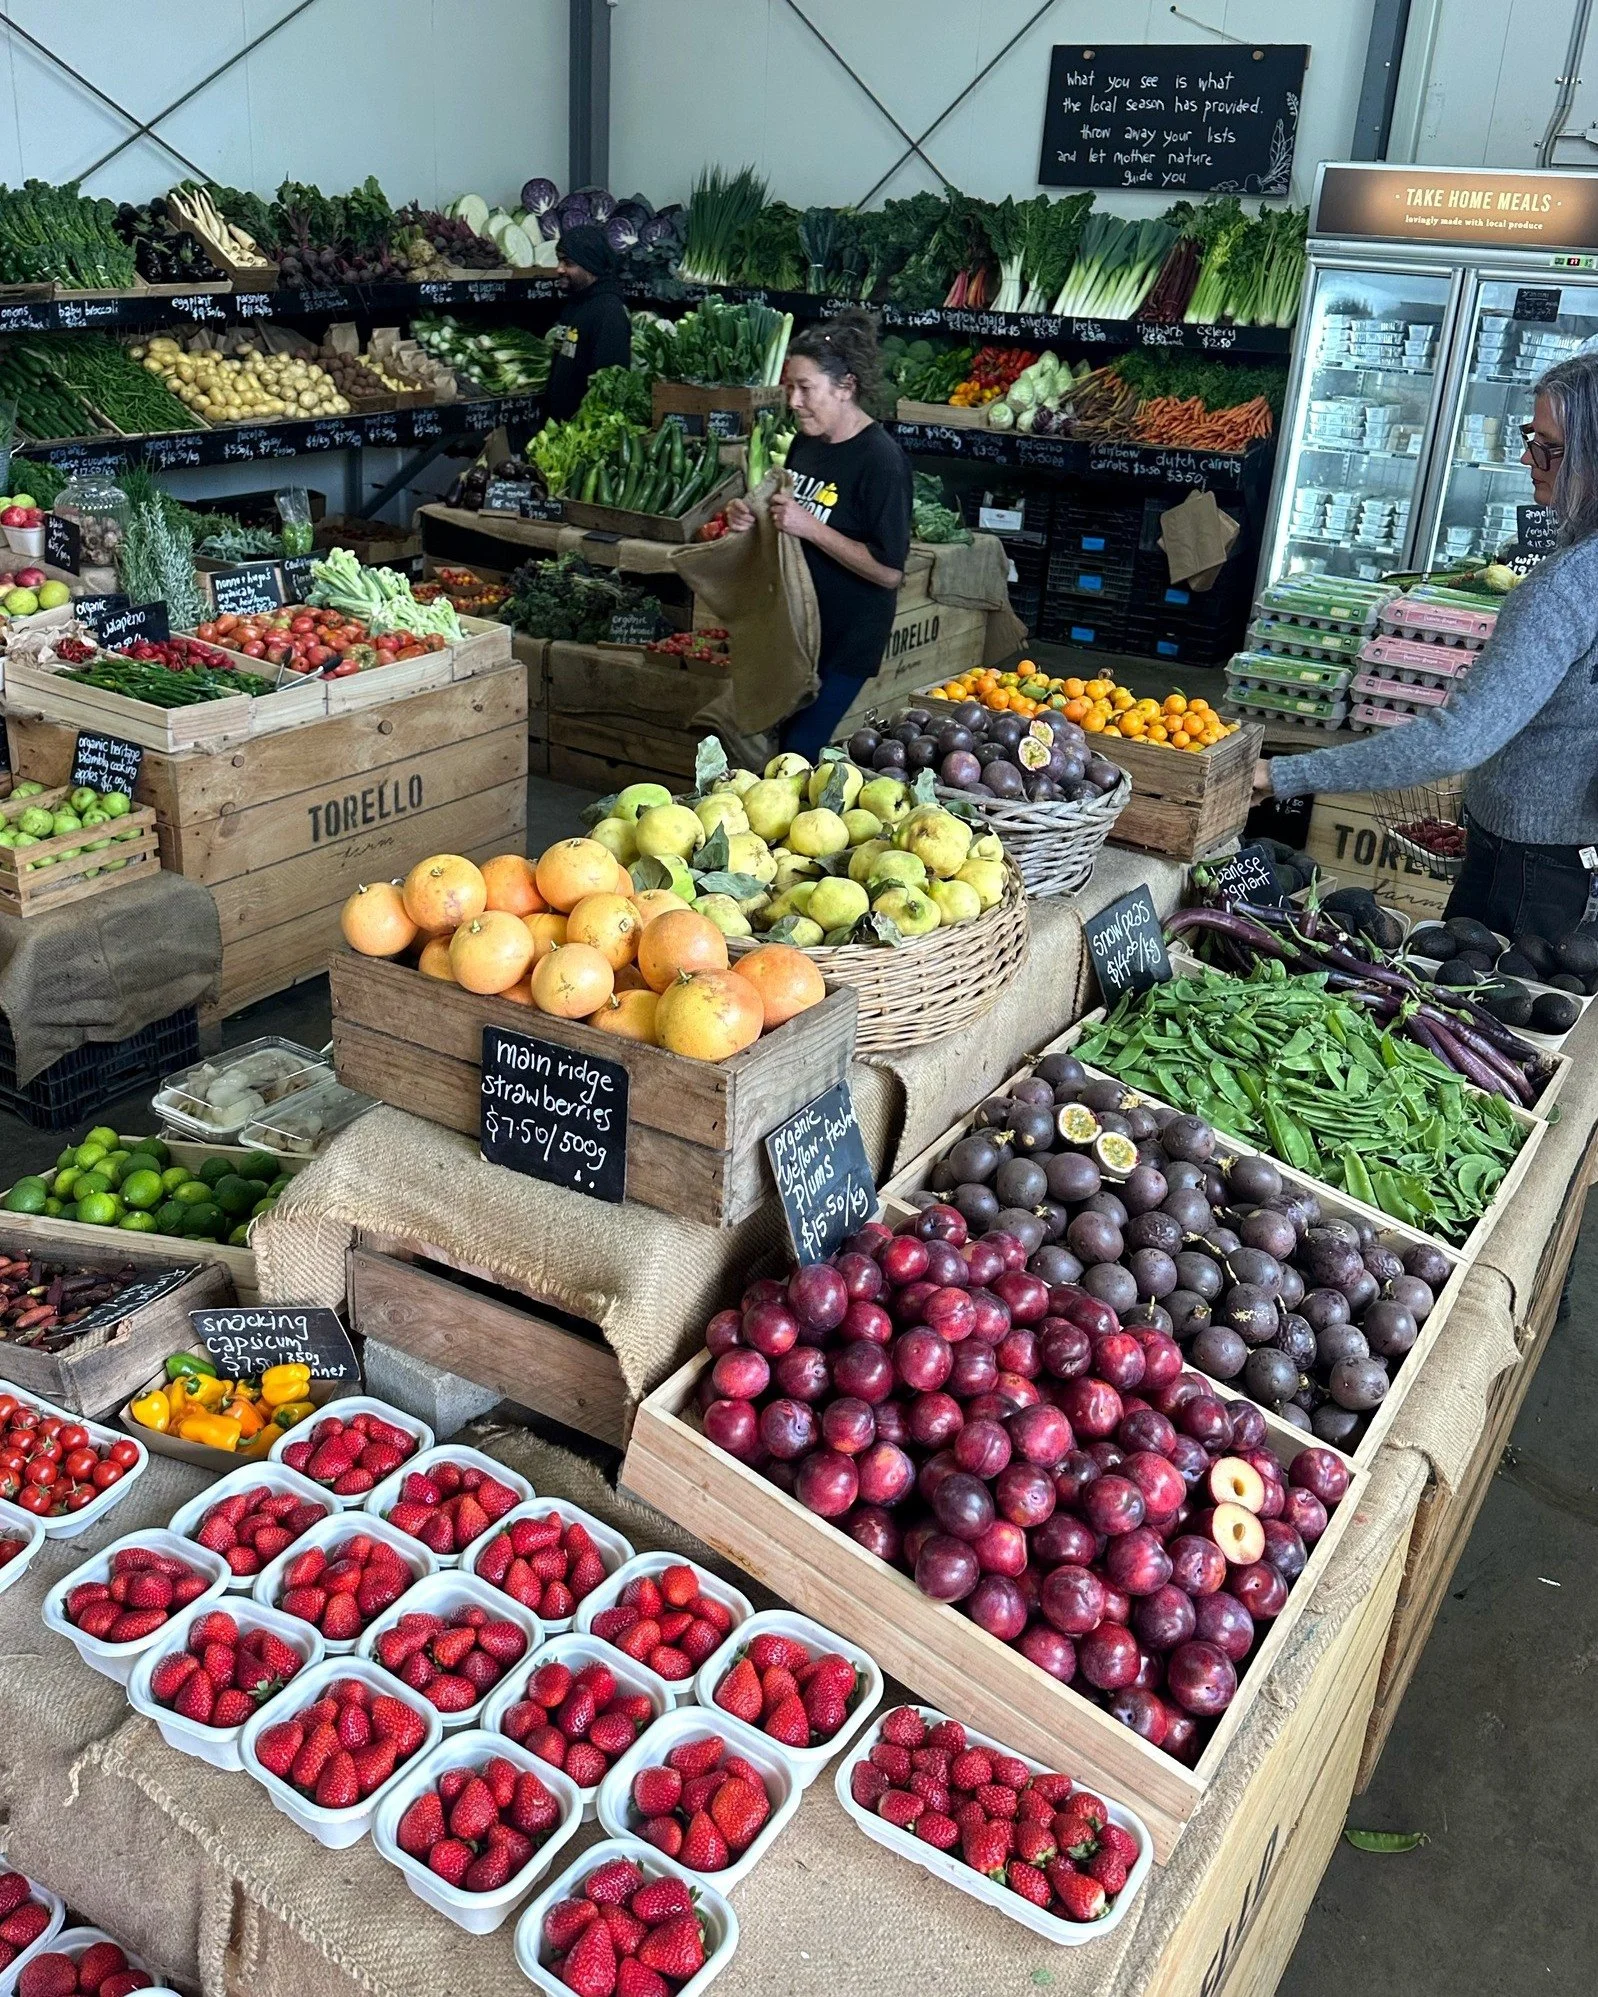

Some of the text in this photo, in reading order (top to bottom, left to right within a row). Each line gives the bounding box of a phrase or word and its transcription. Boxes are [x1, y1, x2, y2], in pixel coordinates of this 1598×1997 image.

[1104, 76, 1130, 92] you
[1140, 75, 1159, 88] see
[1175, 75, 1187, 88] is
[1198, 71, 1235, 92] what
[1063, 95, 1264, 122] the local season has provided.
[1080, 123, 1237, 147] throw away your lists
[1056, 146, 1214, 166] and let mother nature
[1121, 168, 1188, 187] guide you
[1405, 187, 1552, 213] TAKE HOME MEALS
[1405, 214, 1544, 230] lovingly made with local produce
[58, 299, 119, 319] baby broccoli
[171, 293, 214, 312] eggplant
[235, 292, 270, 311] parsnips
[1072, 317, 1102, 334] leeks
[1136, 322, 1185, 337] rhubarb
[1196, 324, 1237, 342] celery
[1202, 336, 1232, 349] $2.50
[1088, 441, 1242, 478] rainbow dutch carrots
[1090, 457, 1130, 474] carrots
[75, 598, 107, 620] organic
[78, 737, 143, 765] organic heritage
[74, 765, 99, 786] apples
[109, 757, 138, 780] cooking
[308, 773, 424, 842] TORELLO
[496, 1038, 614, 1105] main ridge
[774, 1109, 823, 1181] organic
[792, 1153, 835, 1216] plums
[801, 1173, 869, 1260] $15.50/kg
[203, 1310, 309, 1341] snacking
[206, 1332, 302, 1356] capsicum
